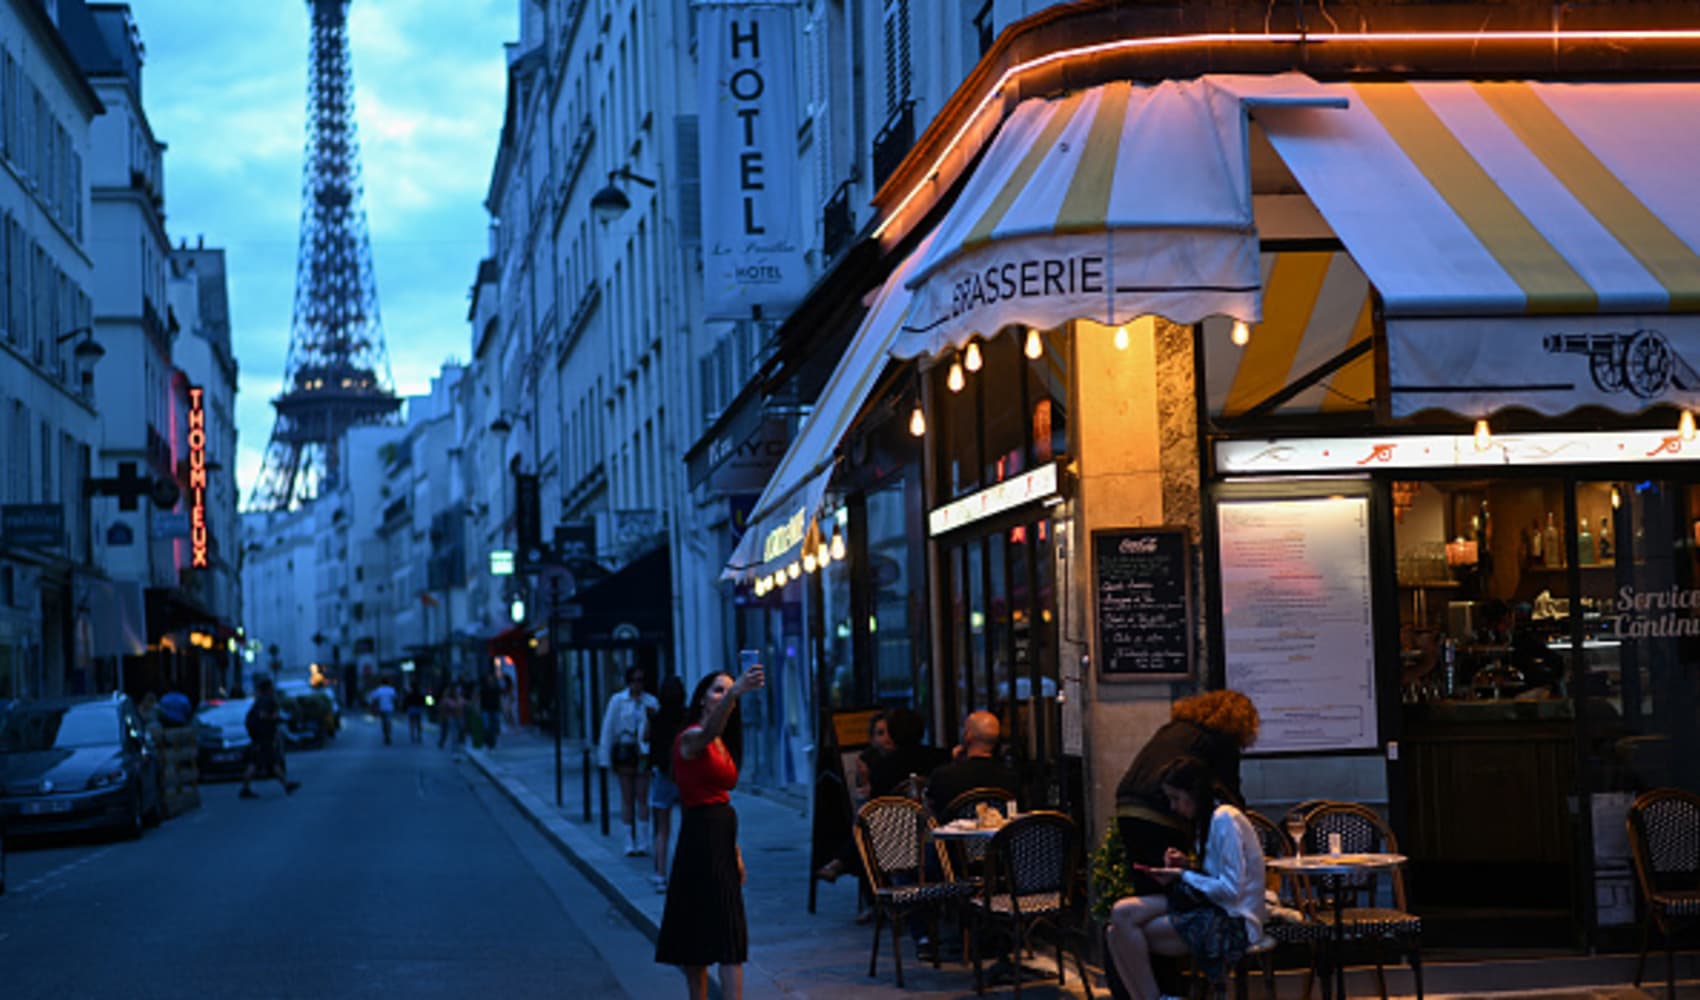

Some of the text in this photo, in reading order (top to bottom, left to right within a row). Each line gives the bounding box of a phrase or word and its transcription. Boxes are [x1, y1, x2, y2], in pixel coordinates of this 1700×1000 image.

[730, 21, 765, 235] HOTEL
[735, 266, 783, 280] HOTEL
[952, 256, 1104, 318] BRASSERIE
[188, 388, 207, 568] THOUMIEUX
[1617, 585, 1700, 611] Service
